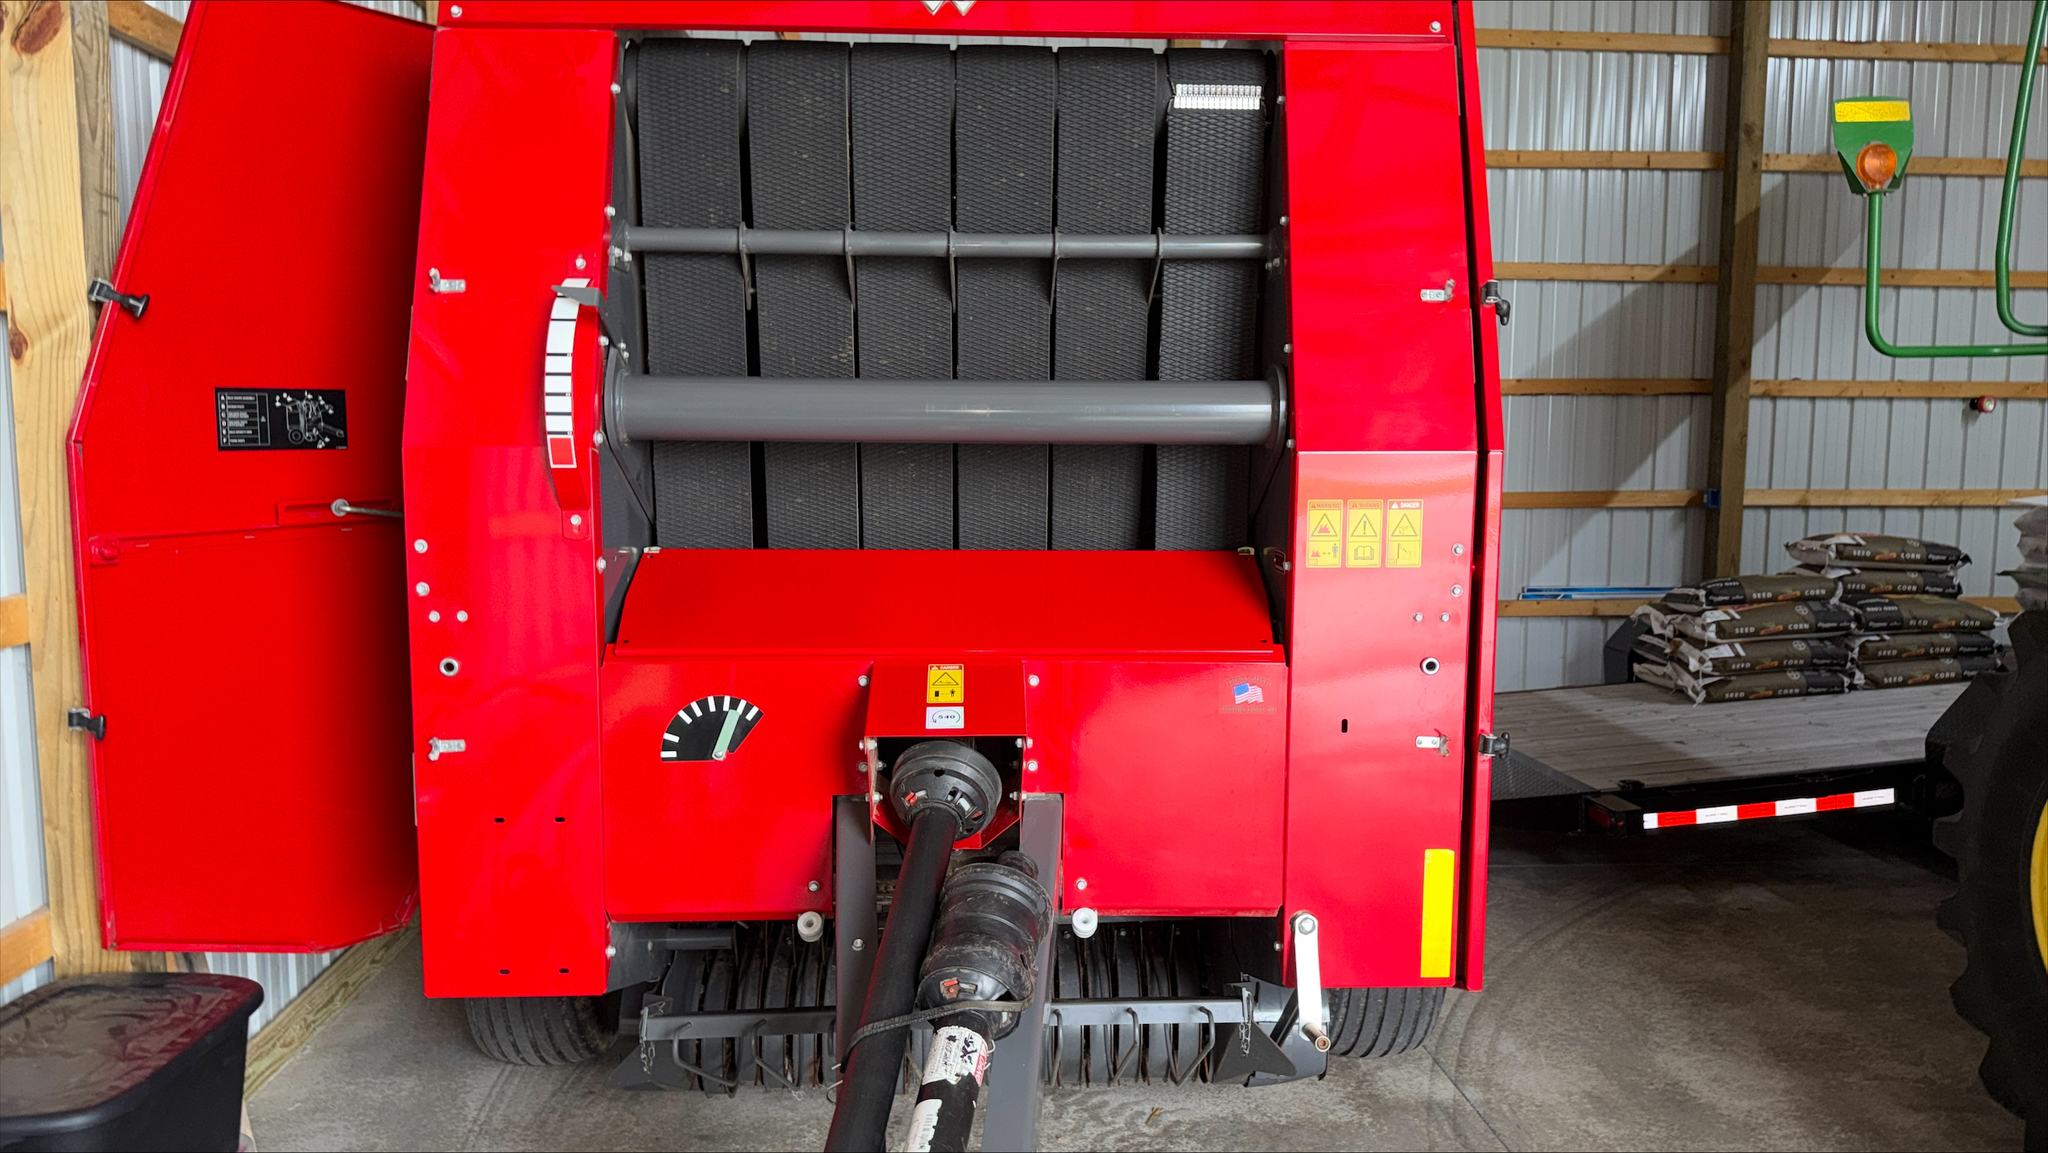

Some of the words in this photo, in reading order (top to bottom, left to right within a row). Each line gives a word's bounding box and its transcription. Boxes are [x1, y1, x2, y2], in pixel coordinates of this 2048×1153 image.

[1901, 552, 1921, 560] CORN
[1752, 592, 1772, 600] SEED
[1735, 626, 1755, 634] SEED
[1731, 662, 1751, 670] SEED
[1883, 676, 1903, 684] SEED
[1934, 671, 1956, 679] CORN
[1725, 691, 1745, 699] SEED
